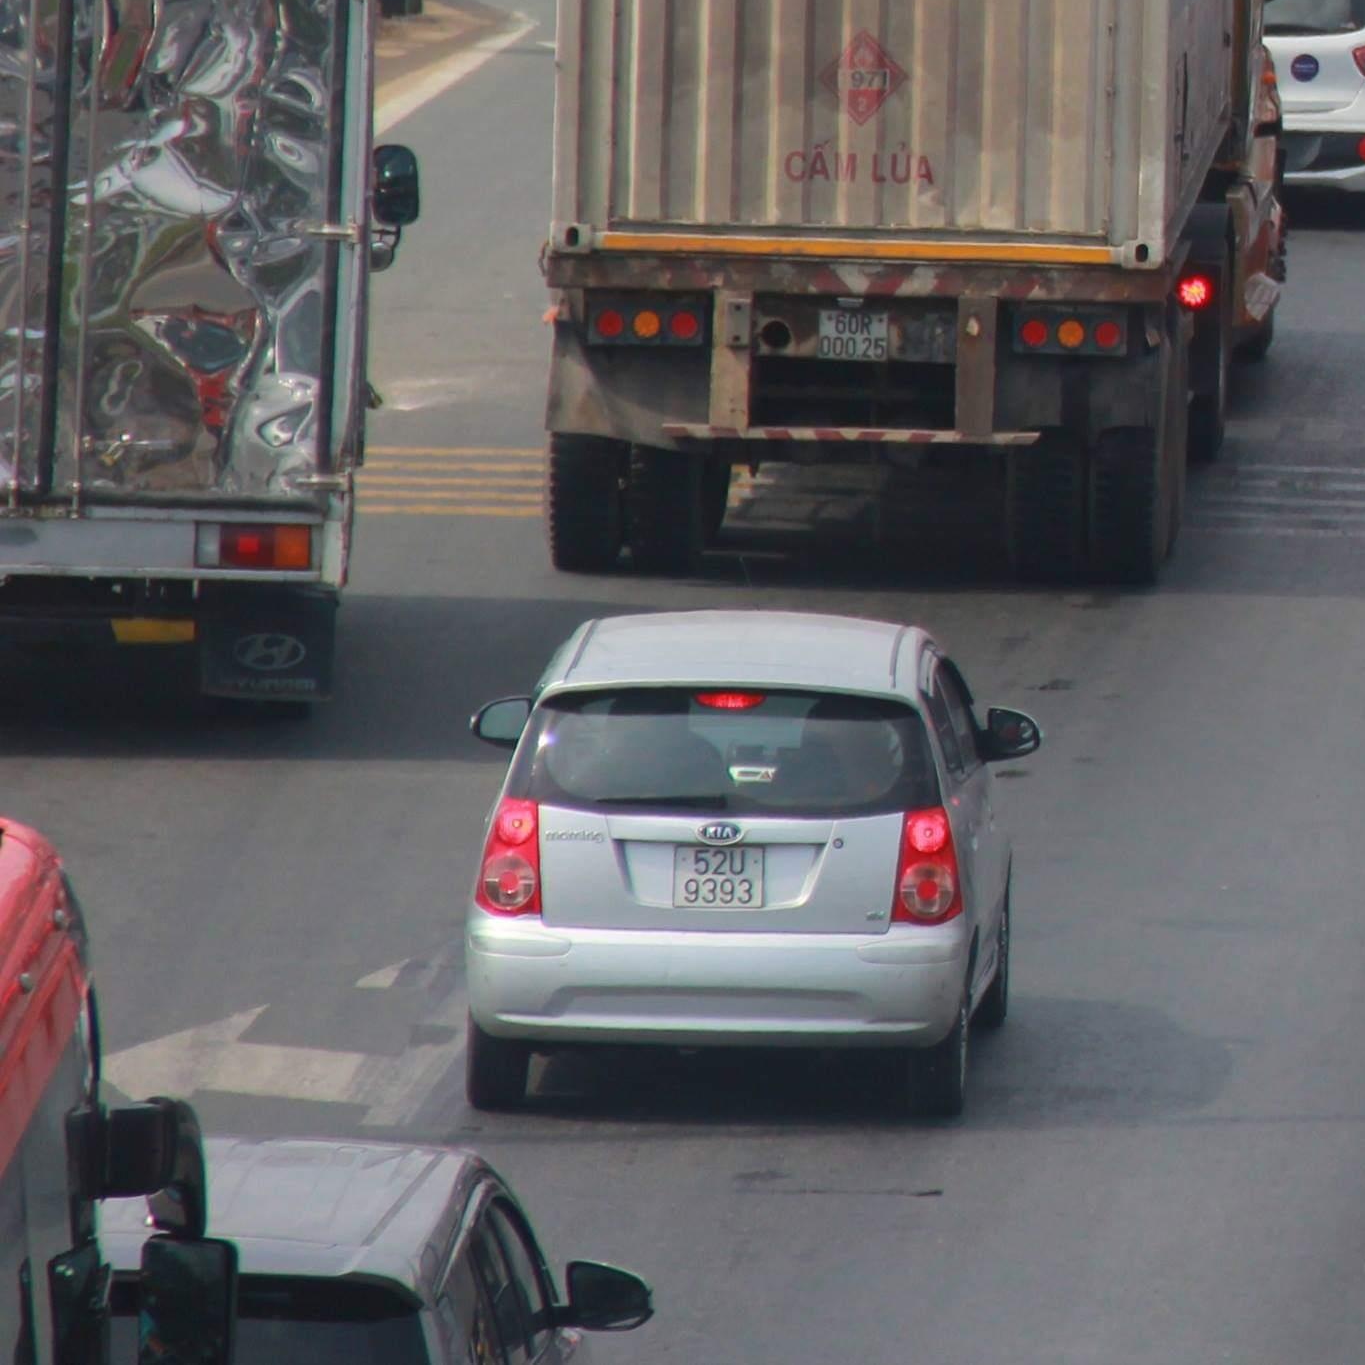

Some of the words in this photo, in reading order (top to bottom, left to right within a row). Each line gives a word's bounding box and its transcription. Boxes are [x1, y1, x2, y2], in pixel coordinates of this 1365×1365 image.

[783, 139, 858, 184] CẤM
[834, 313, 873, 336] 60R
[819, 335, 886, 359] 000.25
[704, 826, 736, 840] KIA
[693, 849, 746, 876] 52U
[683, 877, 754, 905] 9393
